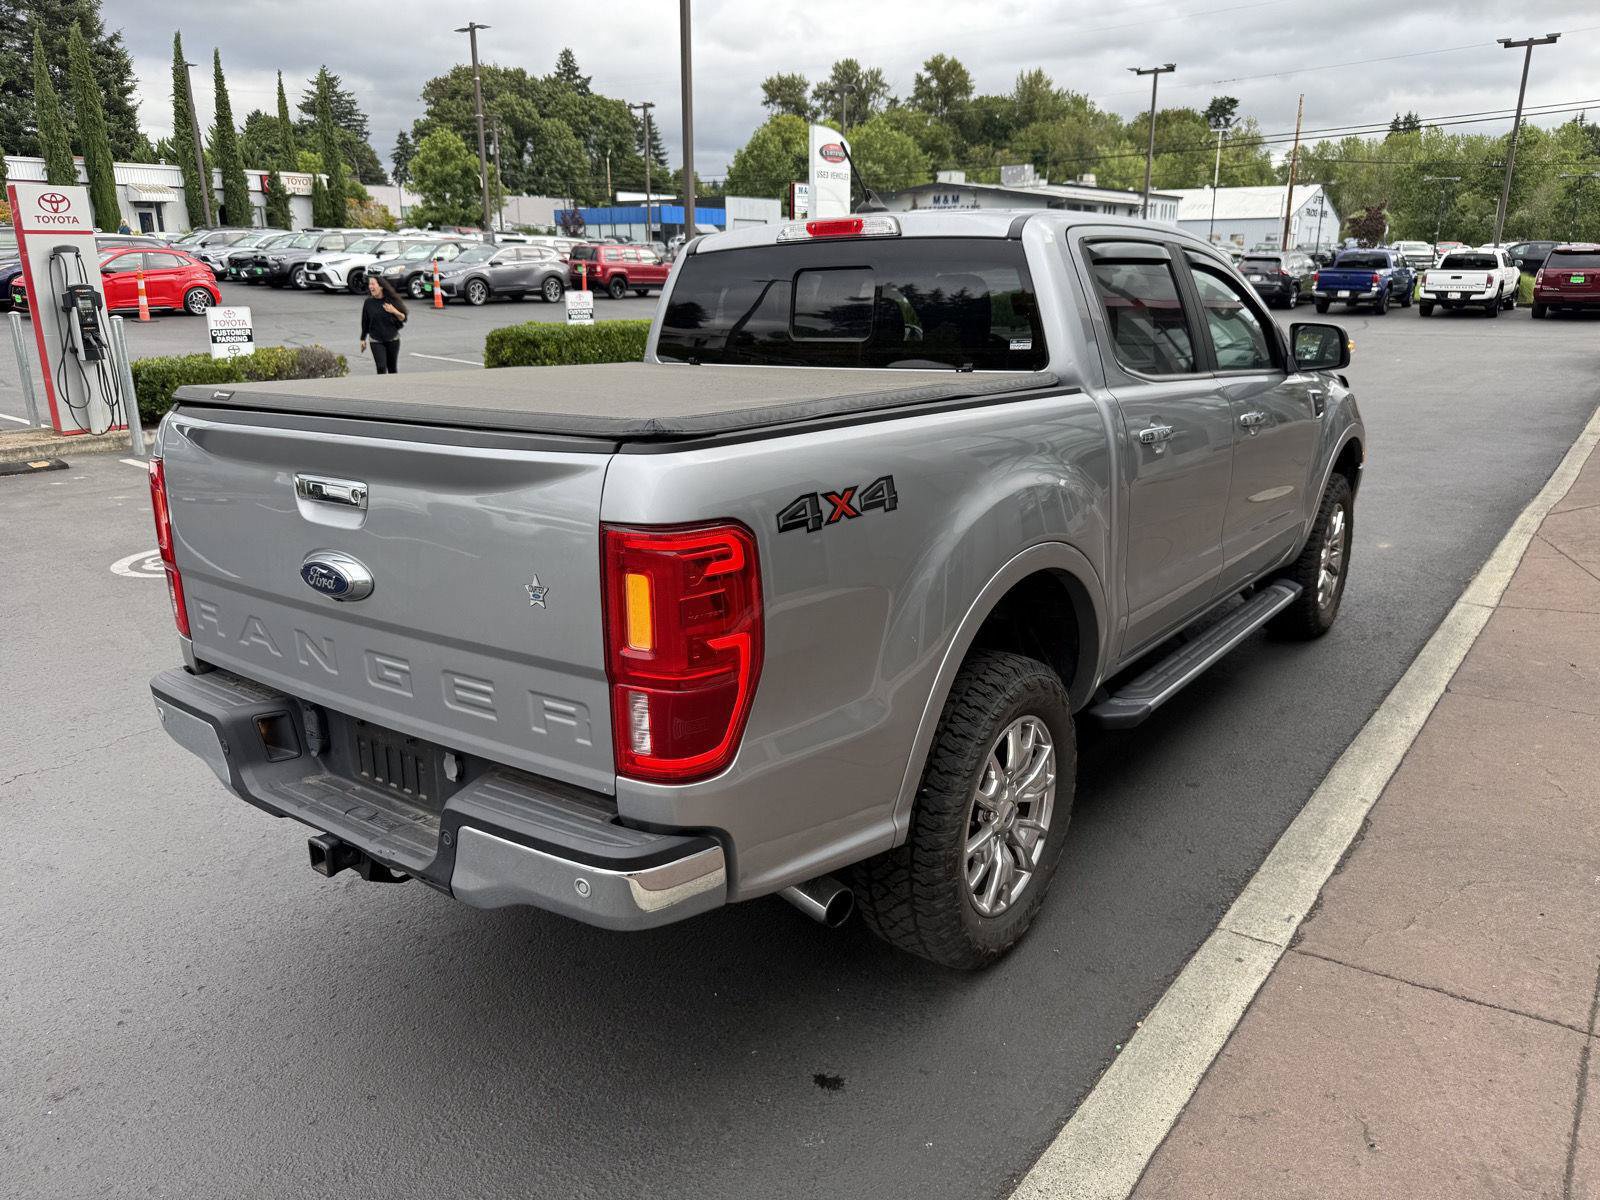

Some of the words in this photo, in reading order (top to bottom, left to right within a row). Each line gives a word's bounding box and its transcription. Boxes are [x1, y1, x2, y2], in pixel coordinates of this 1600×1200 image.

[286, 178, 312, 186] TOYOT
[34, 215, 80, 224] TOYOTA
[214, 319, 248, 327] TOYOTA
[211, 329, 252, 337] CUSTOMER
[216, 335, 249, 343] PARKING
[307, 565, 337, 591] Ford
[192, 597, 593, 747] RANGER
